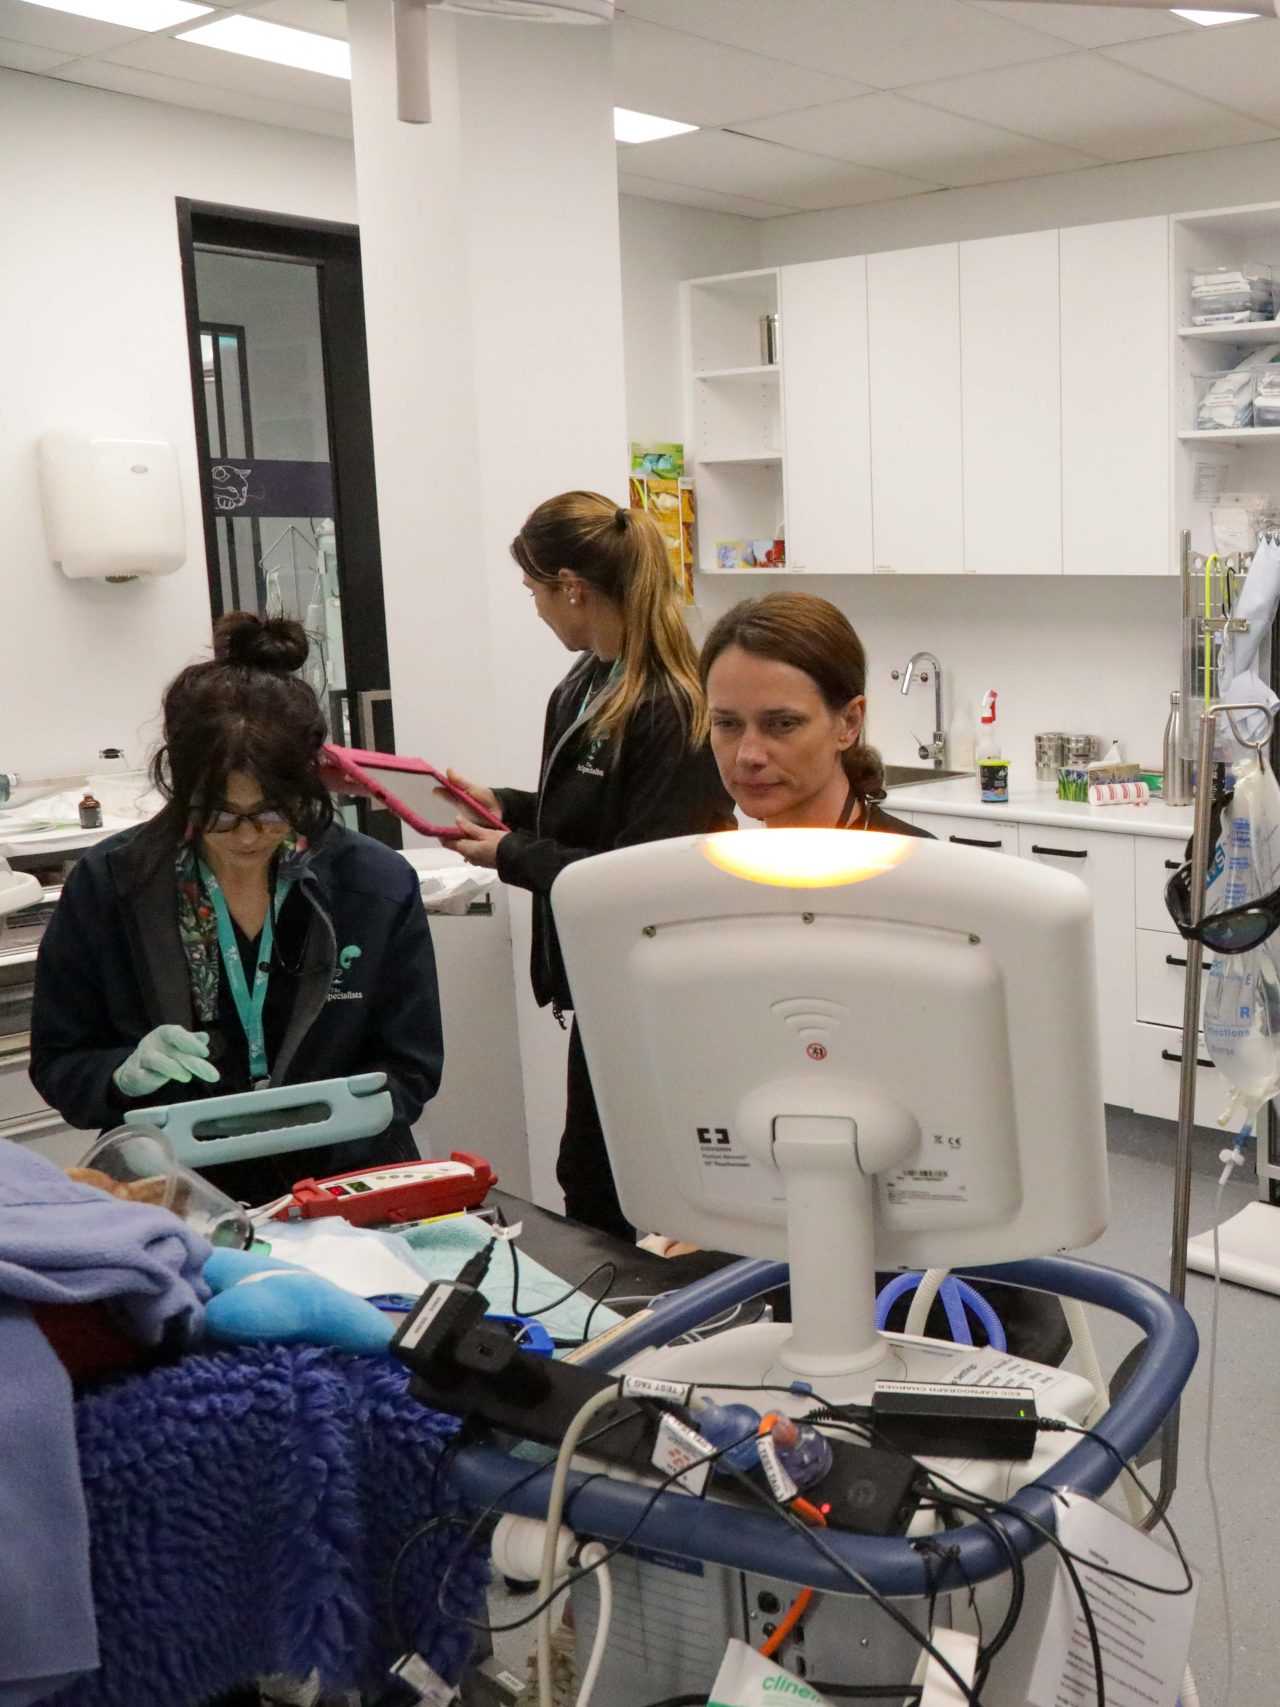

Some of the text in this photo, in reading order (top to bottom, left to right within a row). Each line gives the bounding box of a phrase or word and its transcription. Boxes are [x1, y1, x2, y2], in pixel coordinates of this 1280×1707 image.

[328, 991, 363, 1001] pecialists
[633, 1380, 677, 1395] TEST TAG
[760, 1448, 780, 1491] TEST TAG
[762, 1675, 820, 1703] cline
